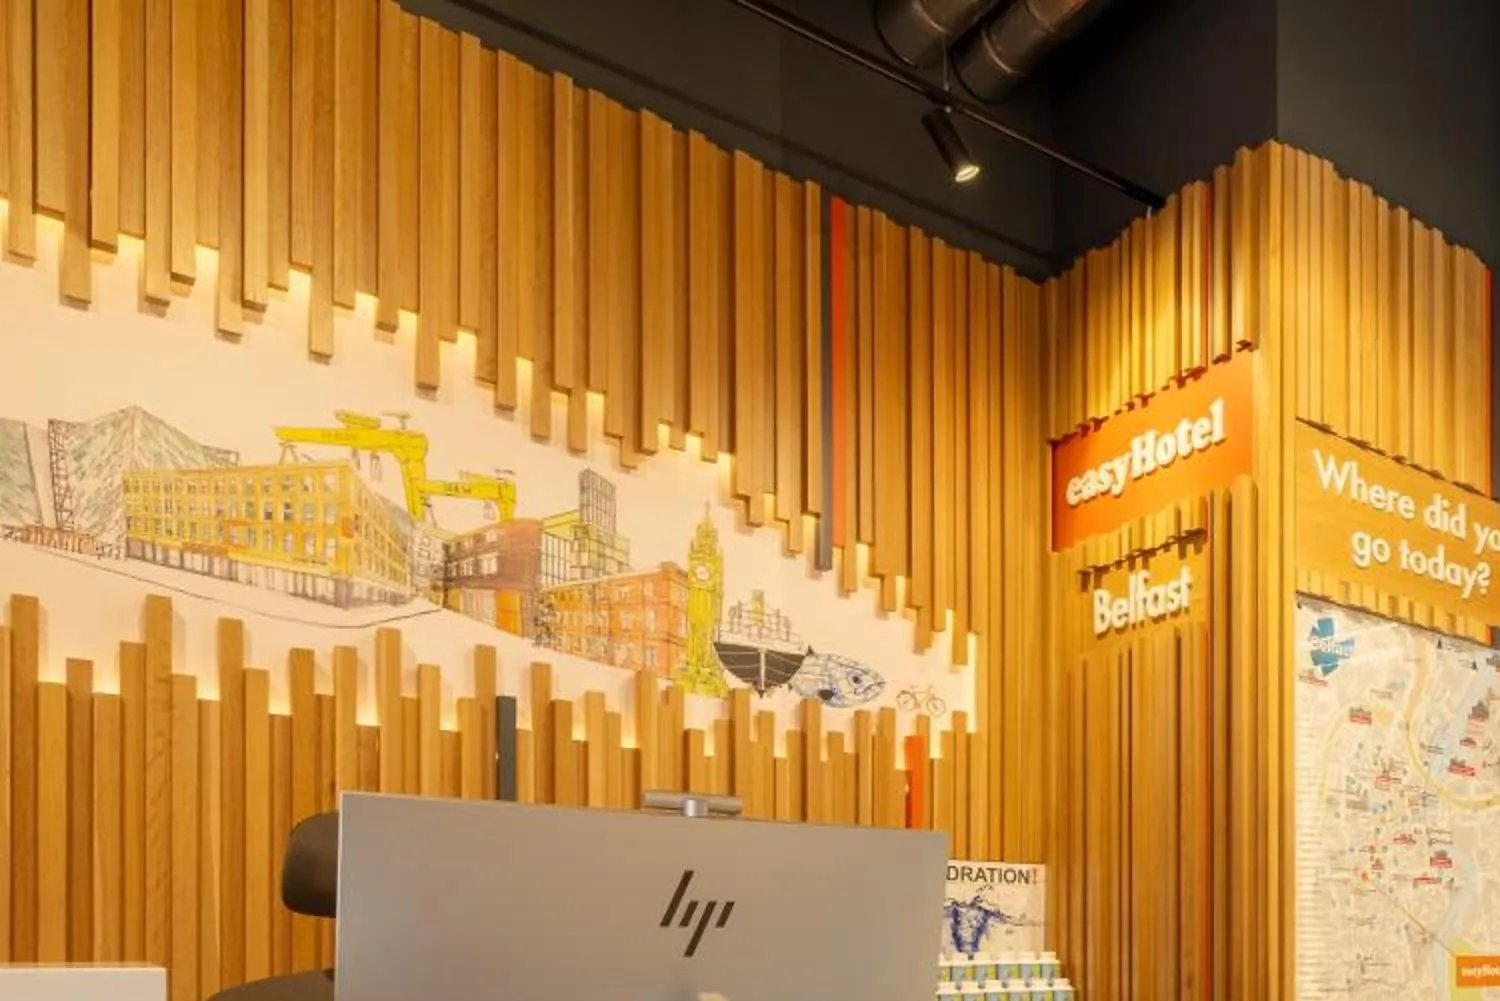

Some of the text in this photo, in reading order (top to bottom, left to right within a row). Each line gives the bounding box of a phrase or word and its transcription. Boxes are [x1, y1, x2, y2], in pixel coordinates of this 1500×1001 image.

[1065, 400, 1226, 506] easyHotel
[1312, 449, 1416, 519] Where
[1424, 496, 1466, 540] did
[1093, 568, 1193, 634] Belfast
[1352, 530, 1492, 598] go today?
[660, 869, 735, 958] hp
